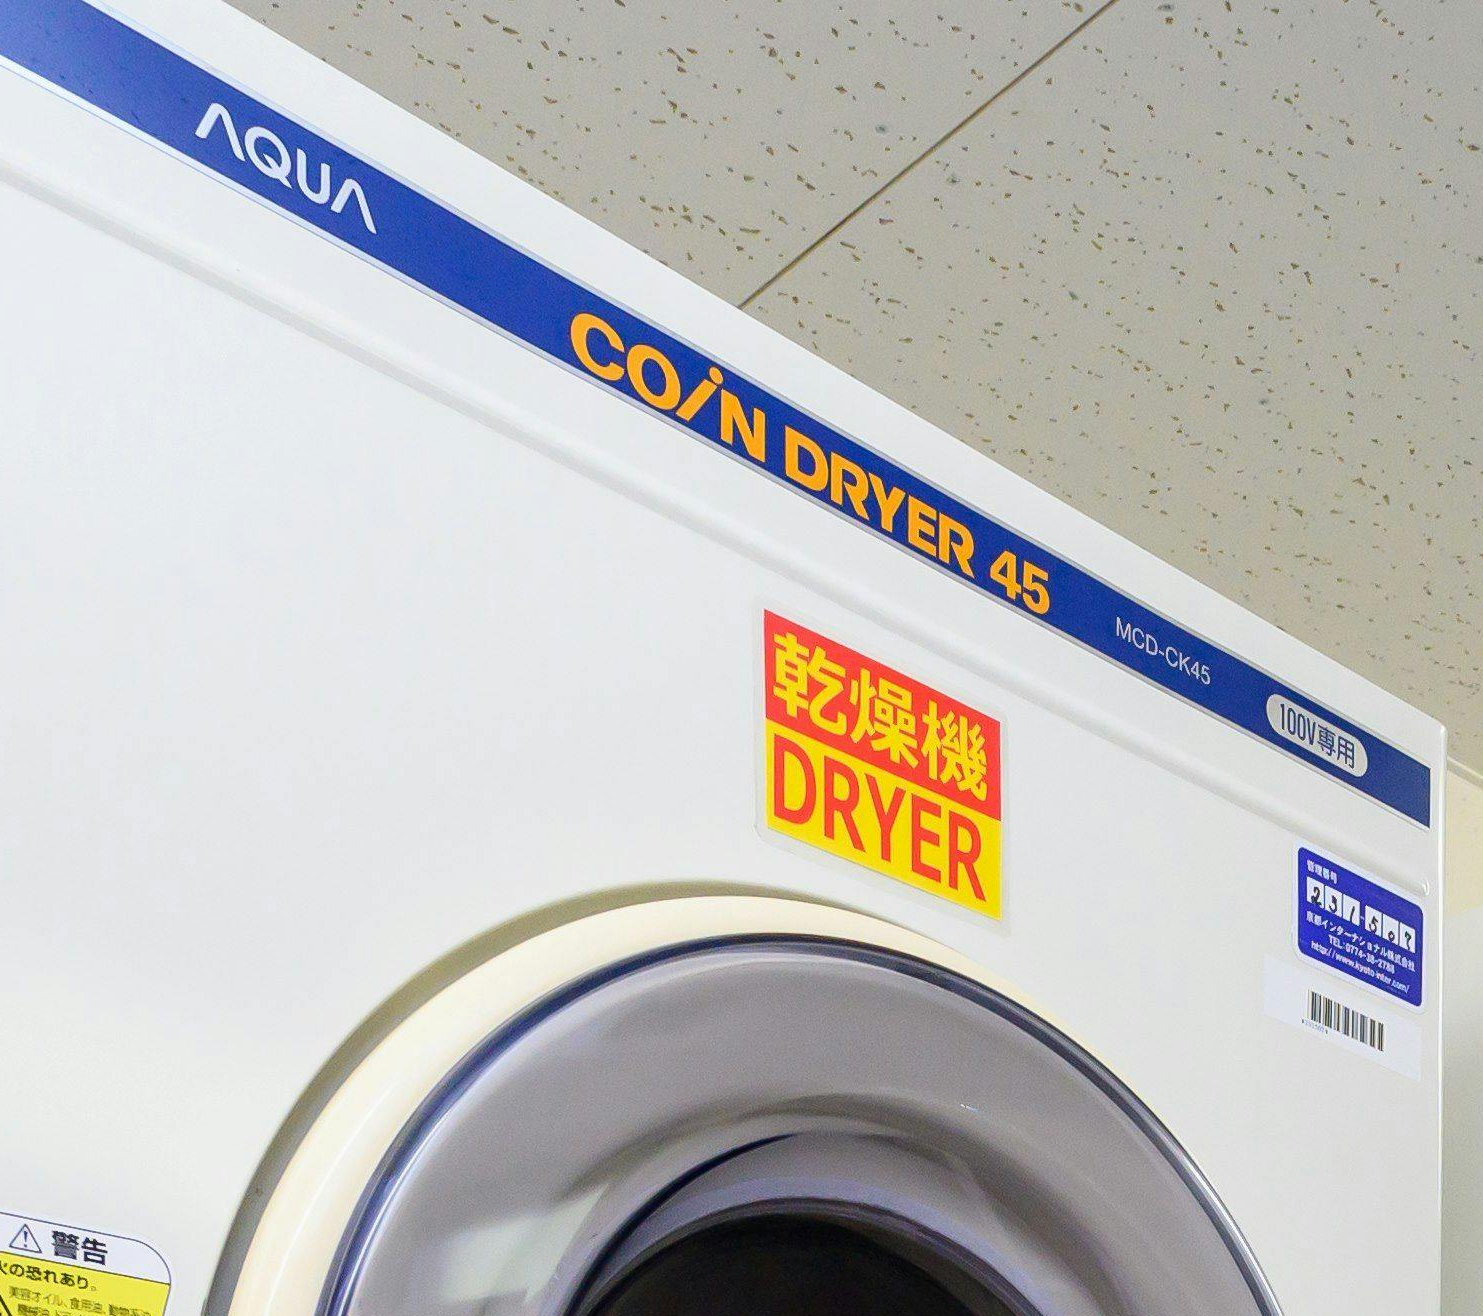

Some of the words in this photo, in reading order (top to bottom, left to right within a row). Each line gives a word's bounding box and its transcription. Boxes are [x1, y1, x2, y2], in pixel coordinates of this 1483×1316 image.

[196, 102, 377, 233] AQUA
[784, 424, 976, 576] DRYER
[990, 551, 1052, 614] 45
[1115, 615, 1212, 688] MCD-CK45
[1277, 702, 1357, 769] 100V専用
[771, 632, 991, 802] 乾燥機
[770, 736, 986, 902] DRYER
[51, 1231, 108, 1266] 警告
